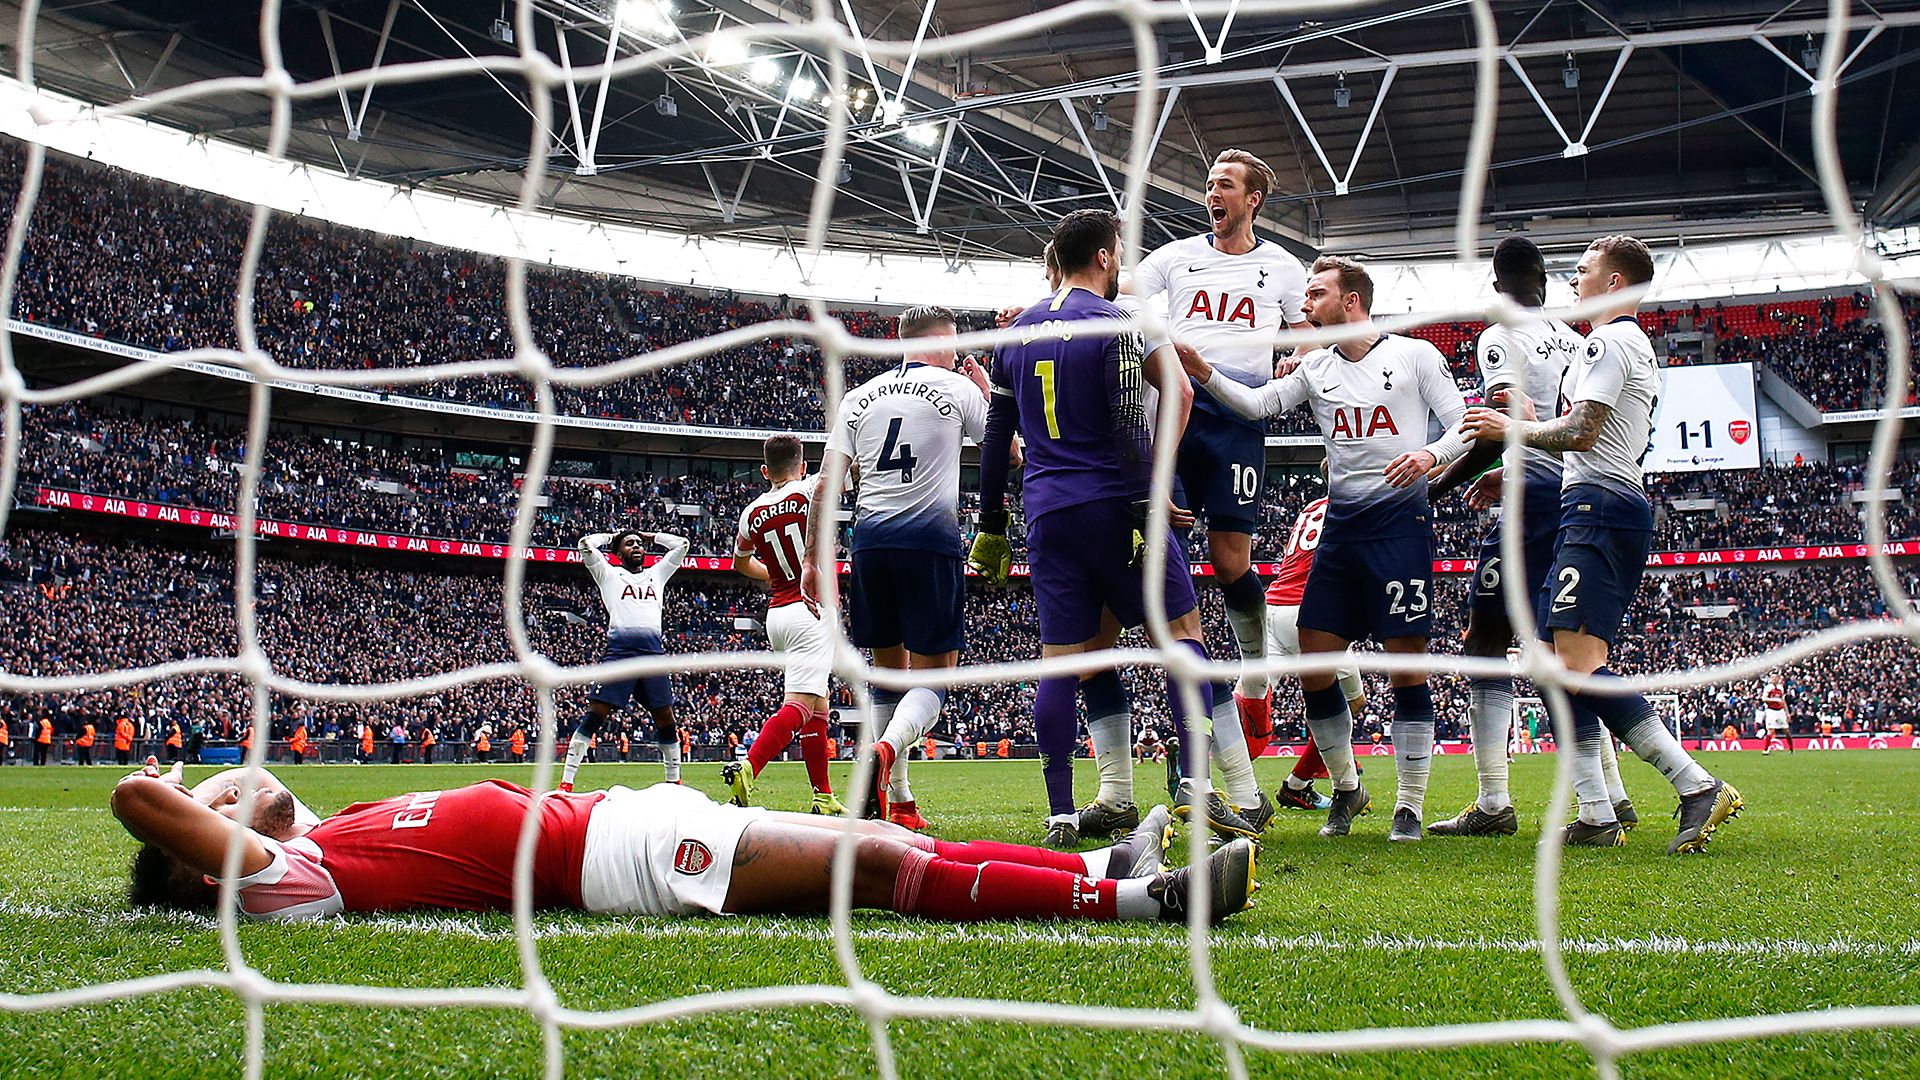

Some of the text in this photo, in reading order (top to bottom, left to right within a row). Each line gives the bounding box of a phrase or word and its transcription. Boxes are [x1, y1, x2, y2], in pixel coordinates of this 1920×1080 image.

[1186, 290, 1255, 328] AIA
[56, 332, 72, 342] SPURS
[88, 340, 102, 348] GAME
[110, 344, 126, 354] ABOUT
[579, 419, 609, 427] TOTTENHAM
[848, 382, 952, 430] ALDERWEIRELD
[1034, 361, 1060, 439] 1
[1331, 405, 1399, 439] AIA
[1676, 420, 1712, 449] 1-1
[876, 417, 917, 483] 4
[1231, 464, 1257, 498] 10
[48, 491, 70, 506] AIA
[104, 499, 126, 514] AIA
[158, 507, 180, 521] AIA
[210, 514, 230, 528] AIA
[260, 521, 279, 534] AIA
[307, 527, 327, 540] AIA
[357, 533, 377, 546] AIA
[407, 538, 428, 551] AIA
[460, 543, 481, 555] AIA
[750, 501, 807, 533] TORREIRA
[1287, 503, 1328, 556] 18
[764, 522, 805, 581] 11
[1464, 560, 1478, 570] AI
[1646, 543, 1906, 565] IA AIA AIA AIA AIA
[1190, 564, 1203, 574] IA
[1480, 557, 1501, 588] 6
[1555, 567, 1580, 603] 2
[621, 585, 656, 600] AIA
[1386, 579, 1427, 614] 23
[1706, 739, 1845, 751] AIA AIA
[679, 844, 690, 870] Arsenal
[1073, 873, 1083, 910] PIERRE
[1082, 877, 1102, 904] 14
